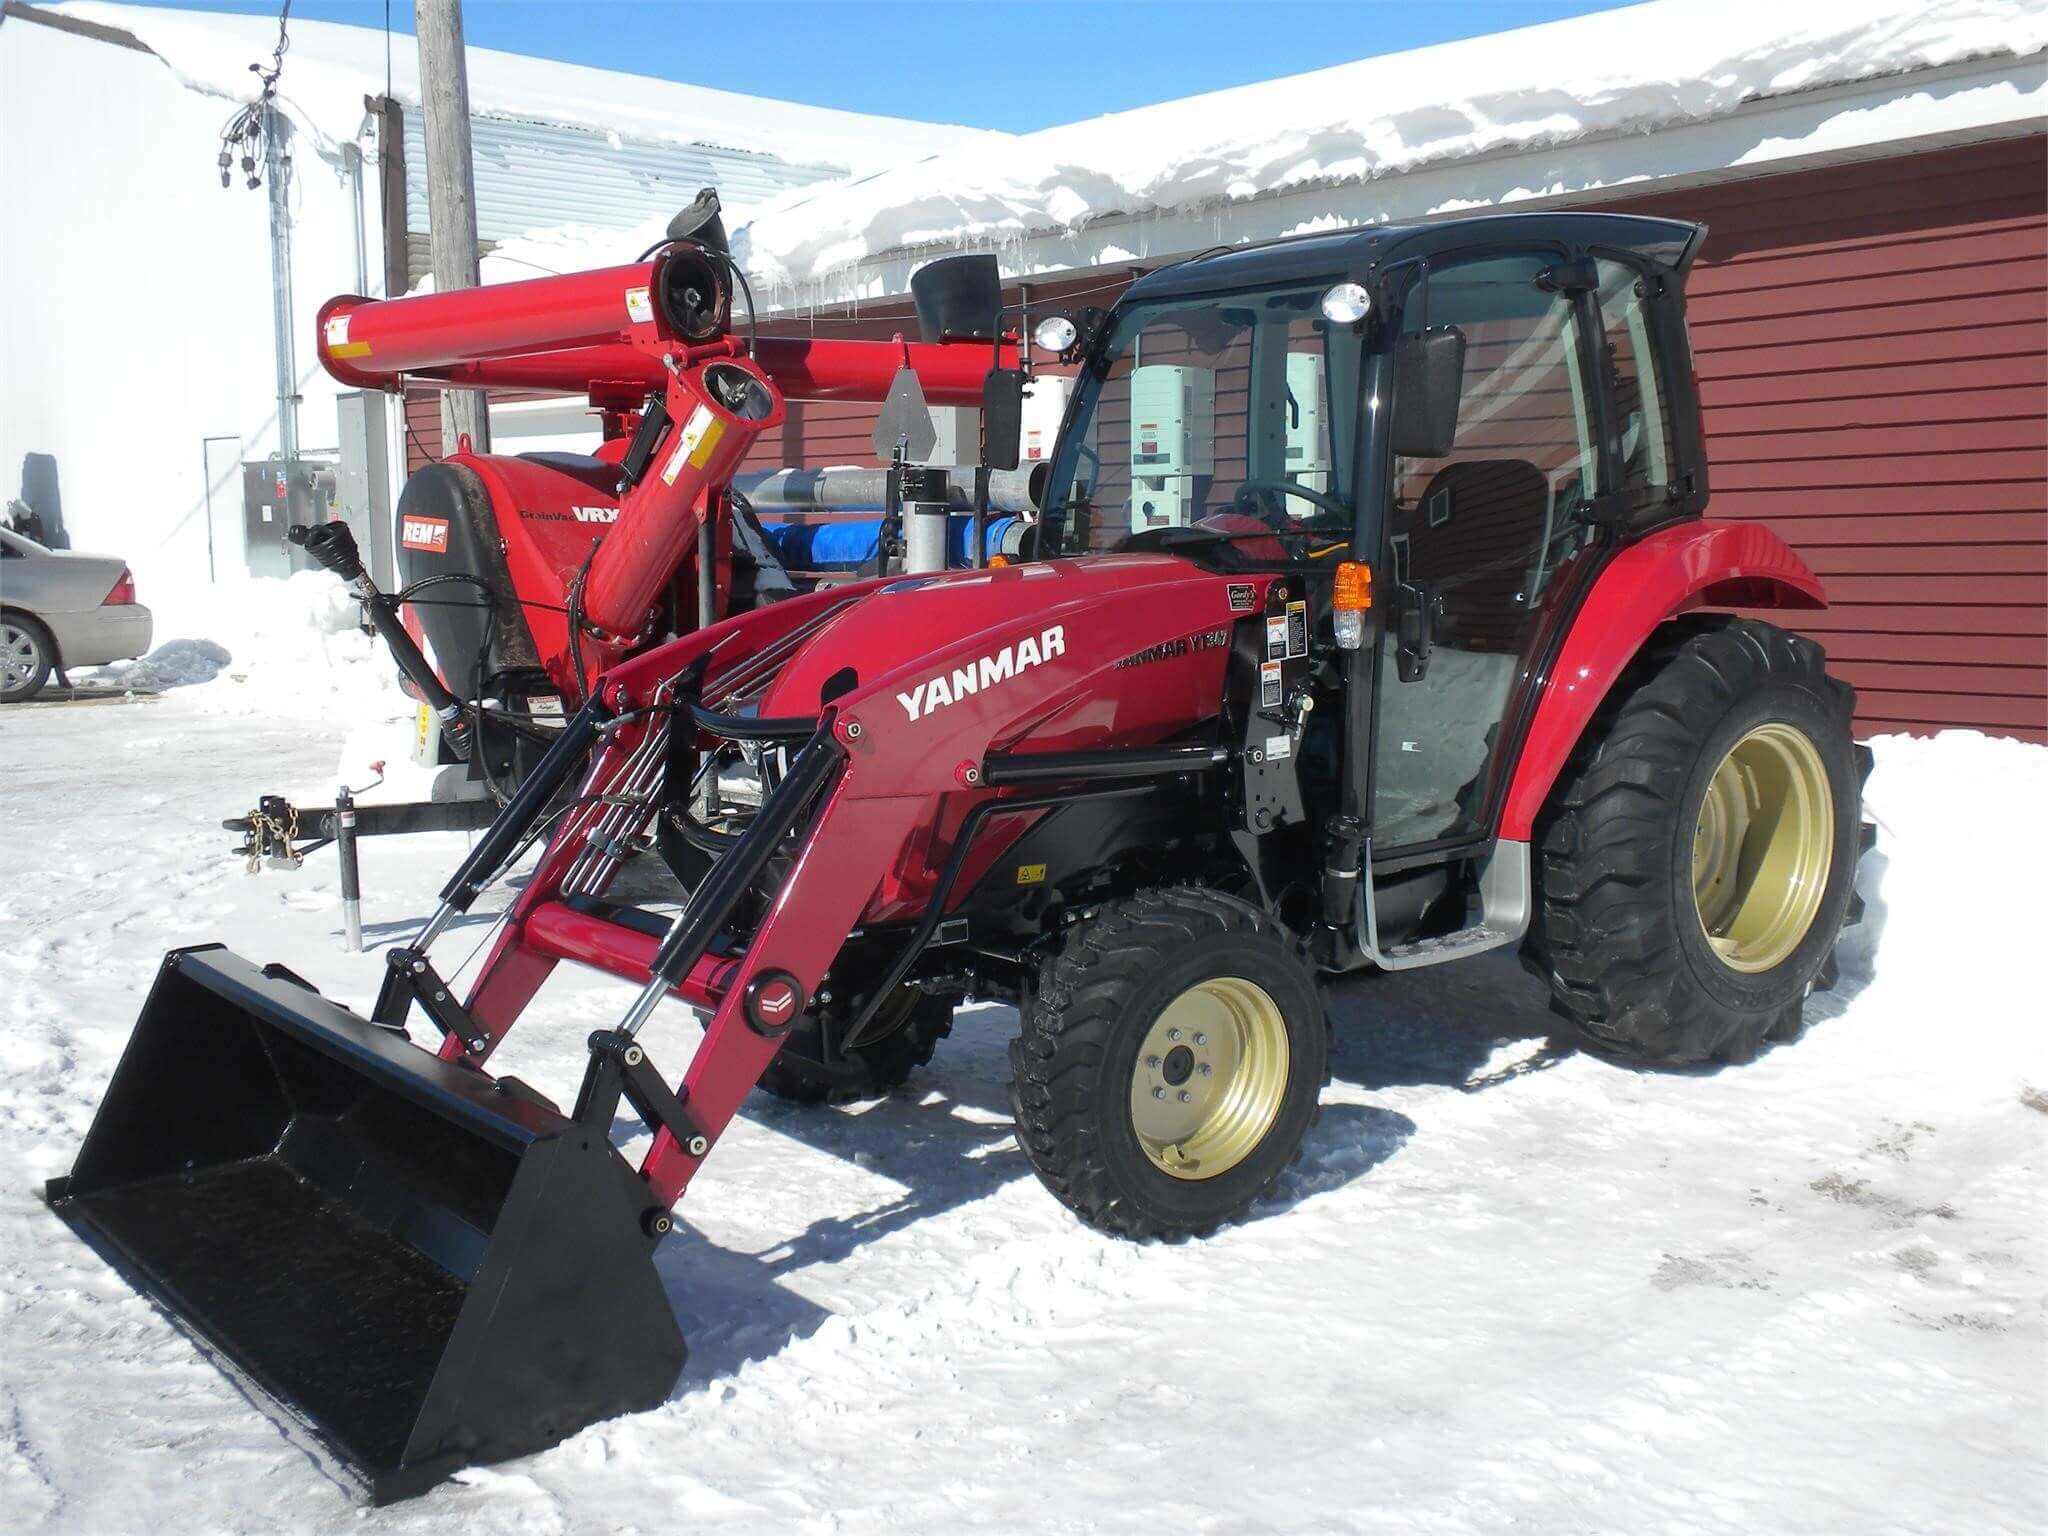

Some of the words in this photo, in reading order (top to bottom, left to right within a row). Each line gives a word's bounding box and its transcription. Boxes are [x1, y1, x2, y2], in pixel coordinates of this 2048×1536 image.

[571, 505, 620, 524] VRX
[403, 521, 434, 545] REM
[896, 625, 1066, 722] YANMAR
